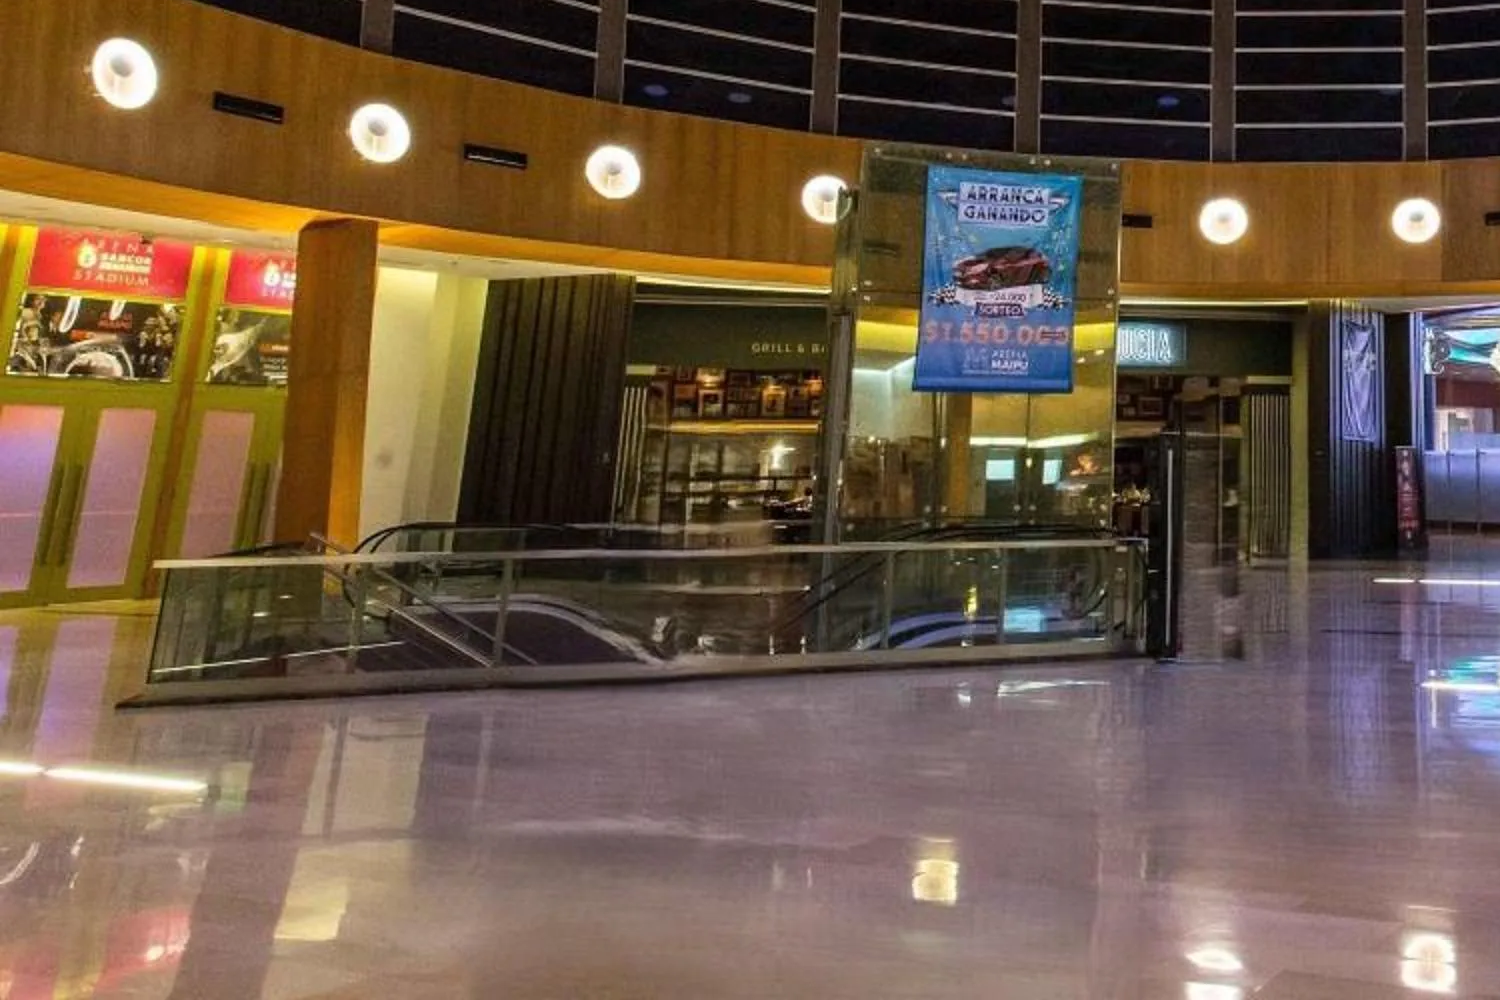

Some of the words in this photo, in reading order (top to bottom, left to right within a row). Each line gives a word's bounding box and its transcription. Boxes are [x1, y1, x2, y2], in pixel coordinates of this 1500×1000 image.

[967, 185, 1045, 204] ARRANCA
[963, 205, 1046, 223] GANANDO
[73, 268, 150, 288] STADIUM
[751, 342, 792, 353] GRILL
[798, 343, 805, 353] &
